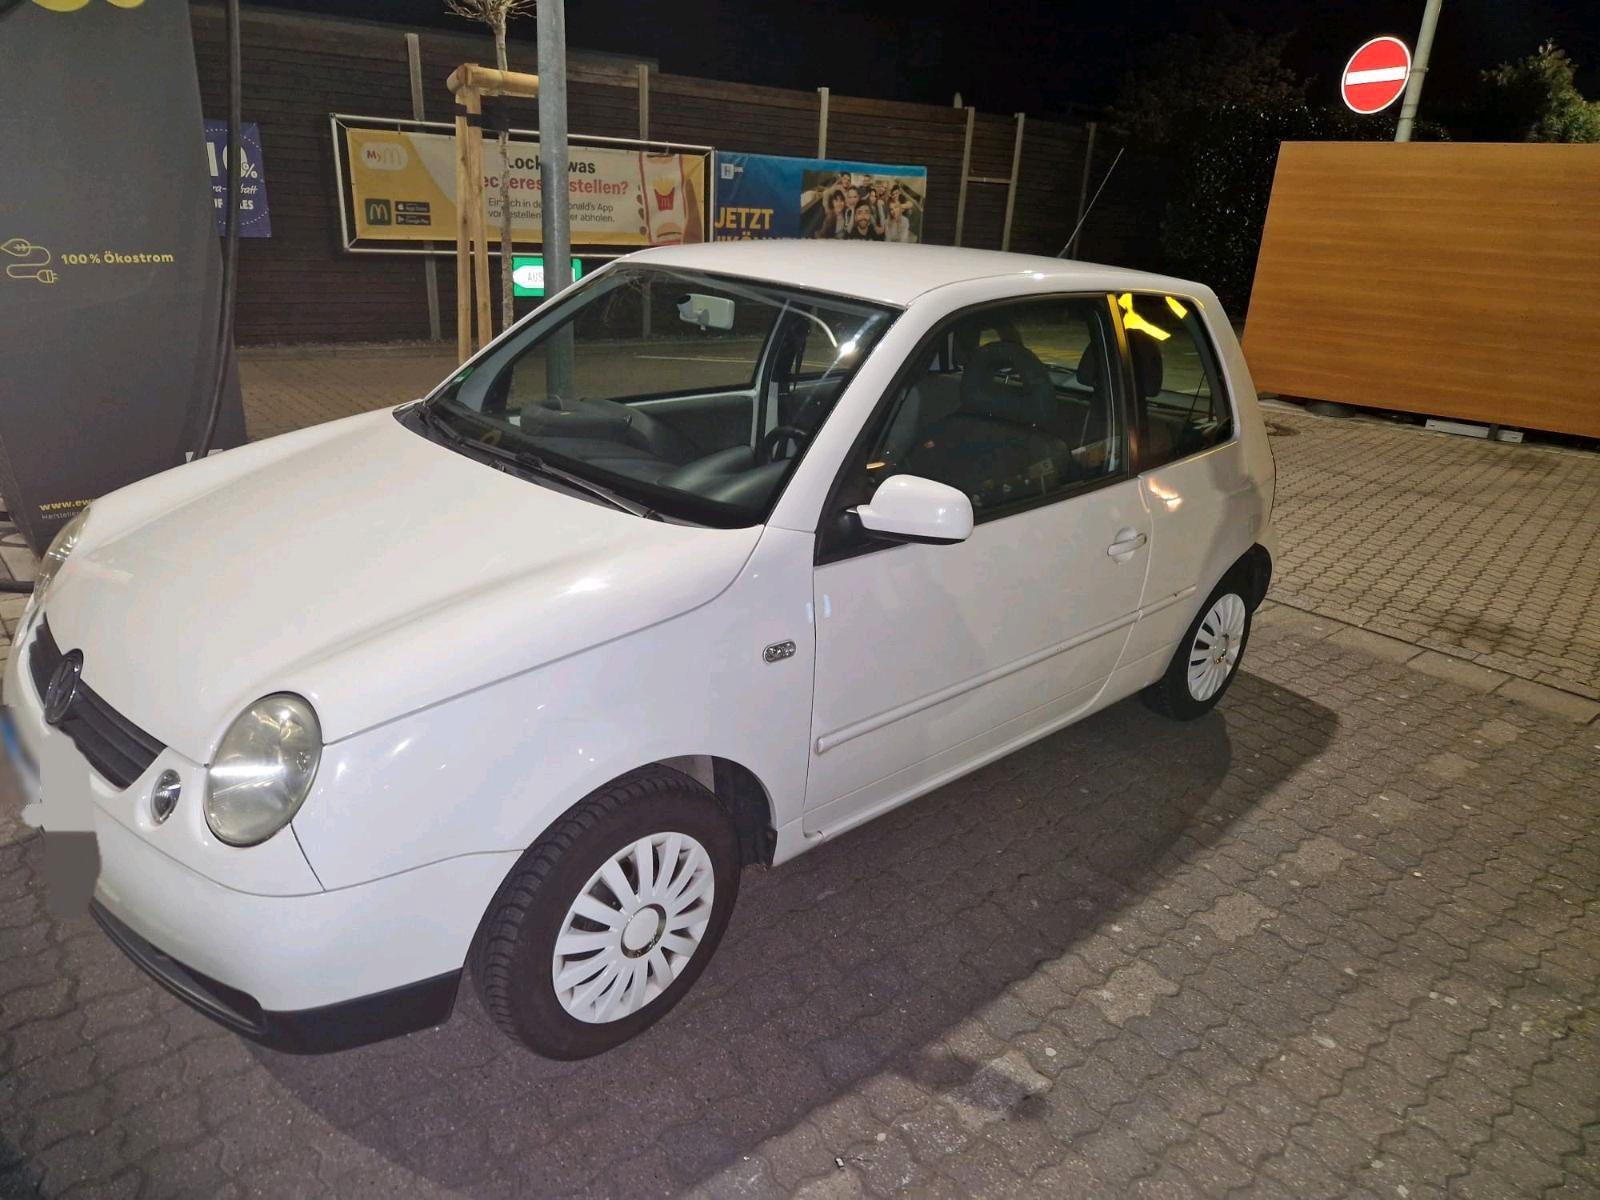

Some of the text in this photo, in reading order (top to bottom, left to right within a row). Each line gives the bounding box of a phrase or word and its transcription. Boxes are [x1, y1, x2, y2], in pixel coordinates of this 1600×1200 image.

[508, 155, 542, 170] ock
[483, 176, 628, 195] eceres stellen?
[715, 207, 774, 230] JETZT
[103, 251, 174, 264] Ökostrom
[39, 499, 94, 511] www.ew
